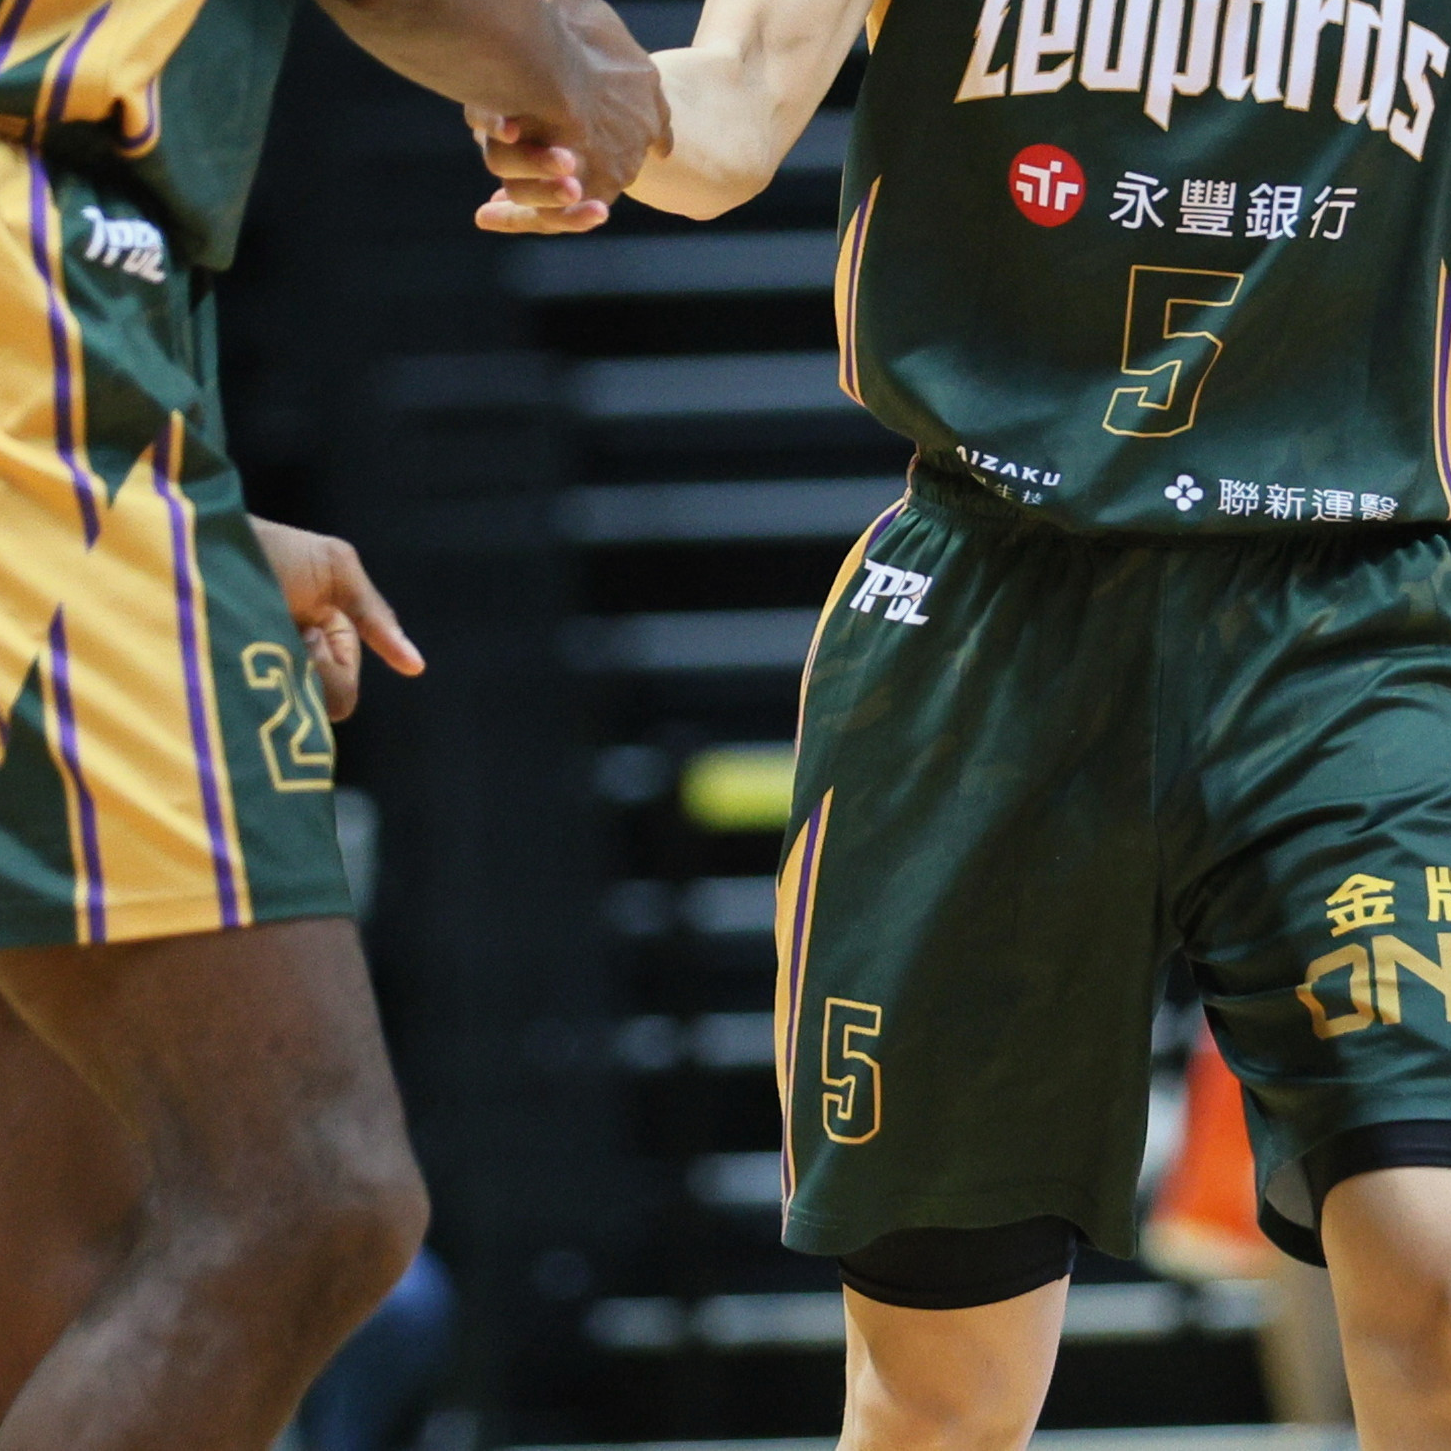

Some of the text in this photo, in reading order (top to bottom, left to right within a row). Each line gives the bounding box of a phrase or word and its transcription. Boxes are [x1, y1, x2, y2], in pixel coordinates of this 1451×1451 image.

[1109, 171, 1358, 241] 永豐銀行
[1102, 264, 1244, 438] 5
[849, 558, 933, 625] TPBL
[241, 641, 337, 793] 2
[821, 997, 882, 1145] 5
